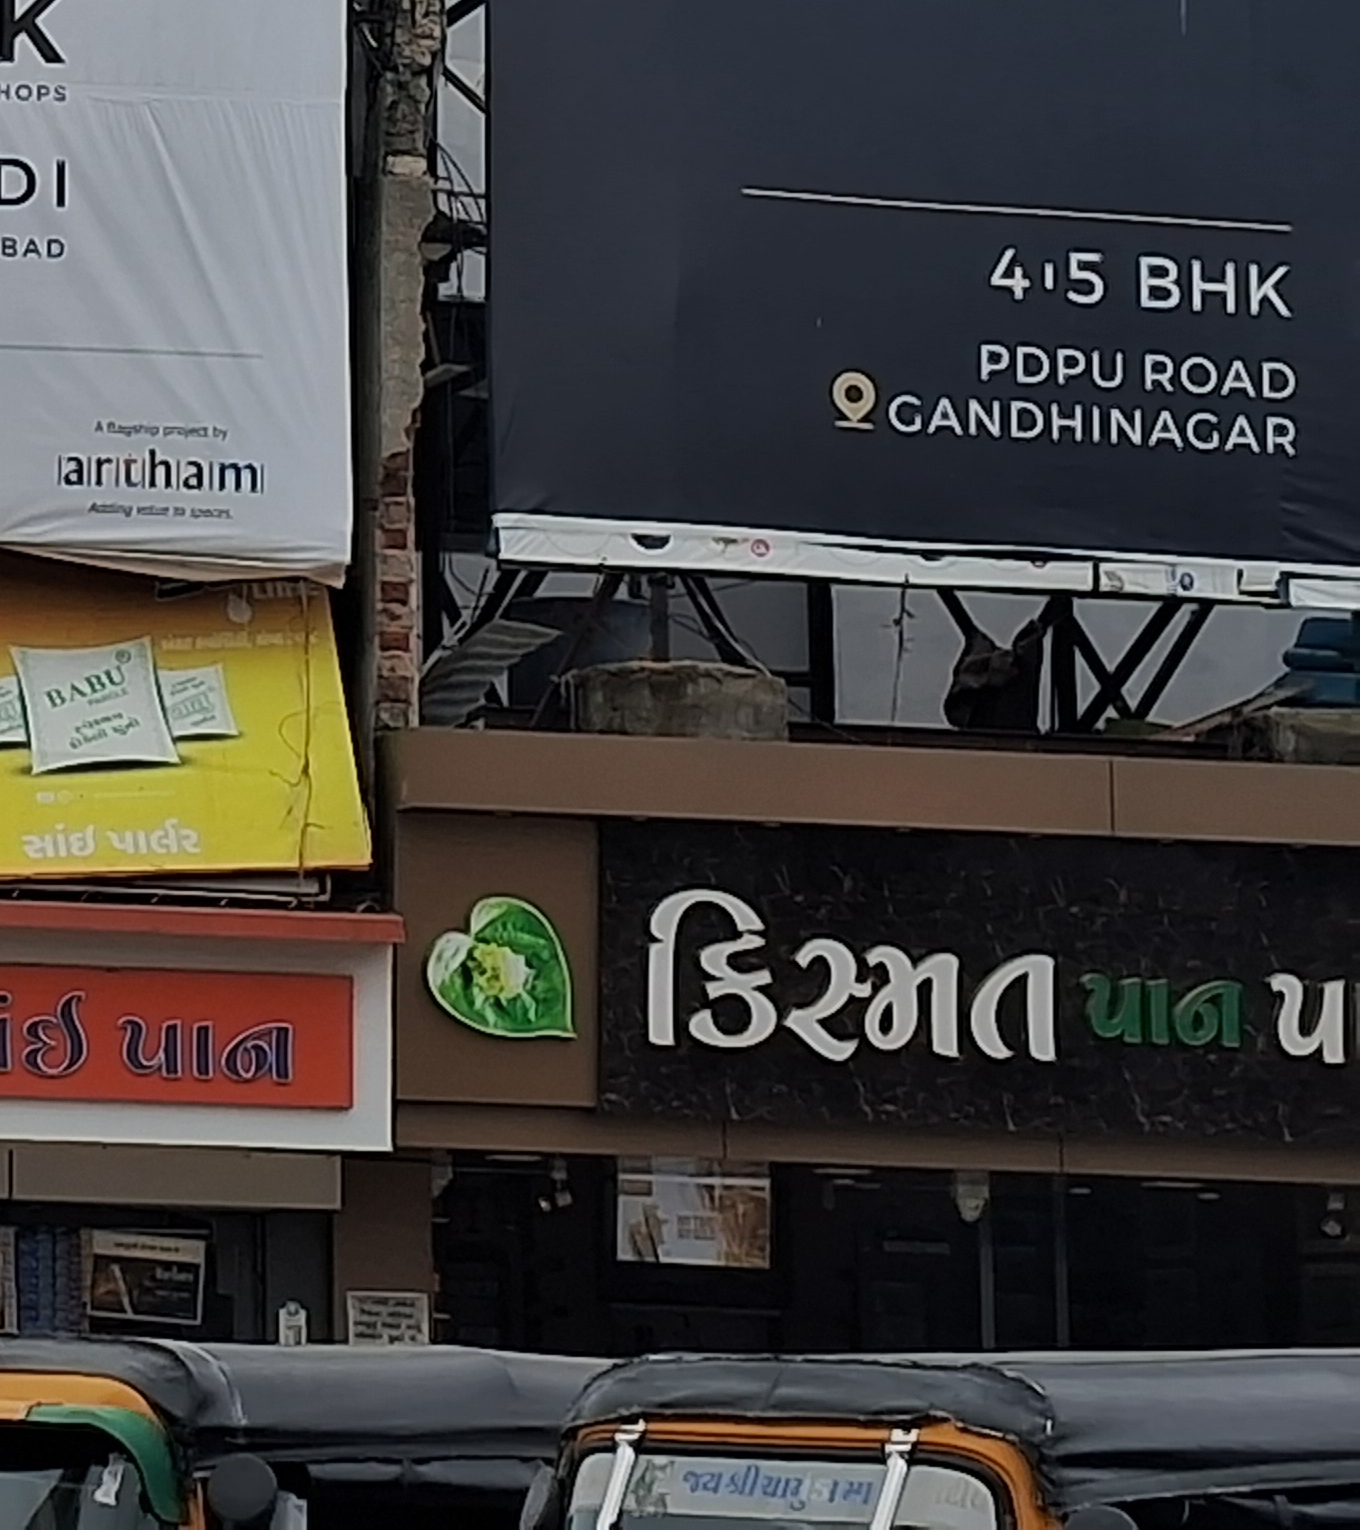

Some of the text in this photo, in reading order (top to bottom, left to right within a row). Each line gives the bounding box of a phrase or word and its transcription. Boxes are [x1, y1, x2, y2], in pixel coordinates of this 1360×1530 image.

[1138, 255, 1294, 318] BHK
[979, 343, 1297, 400] PDPU ROAD
[887, 394, 1297, 458] GANDHINAGAR
[43, 665, 127, 709] BABU
[107, 818, 202, 855] પાર્લર
[648, 888, 1360, 1064] કિસ્મત પાન પ
[117, 1015, 294, 1083] પાન
